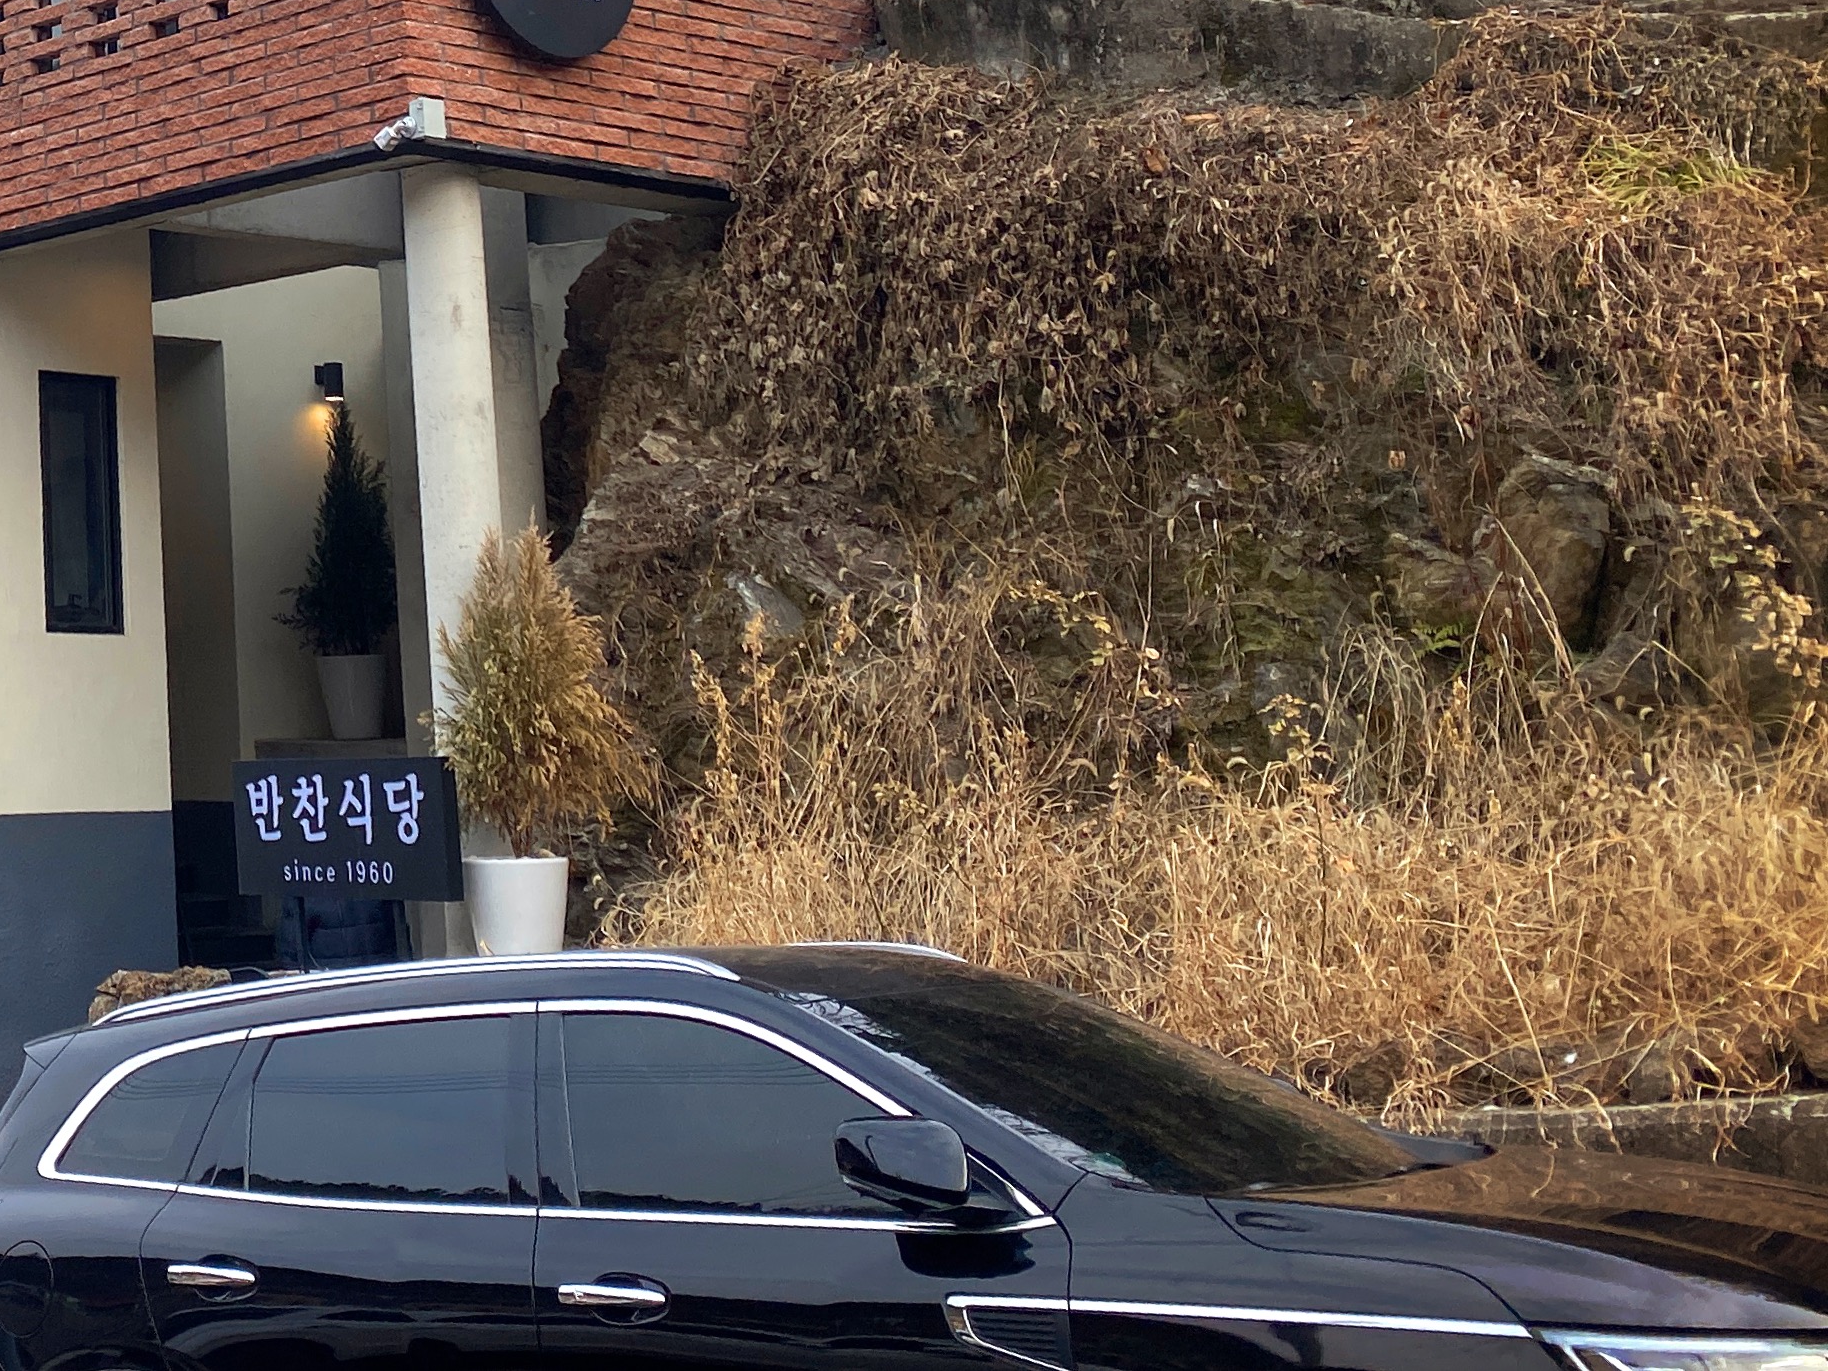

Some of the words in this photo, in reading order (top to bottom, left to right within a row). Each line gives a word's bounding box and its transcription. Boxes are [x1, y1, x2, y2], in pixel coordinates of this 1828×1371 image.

[245, 772, 425, 845] 반찬식당
[283, 859, 336, 882] since
[346, 860, 394, 884] 1960
